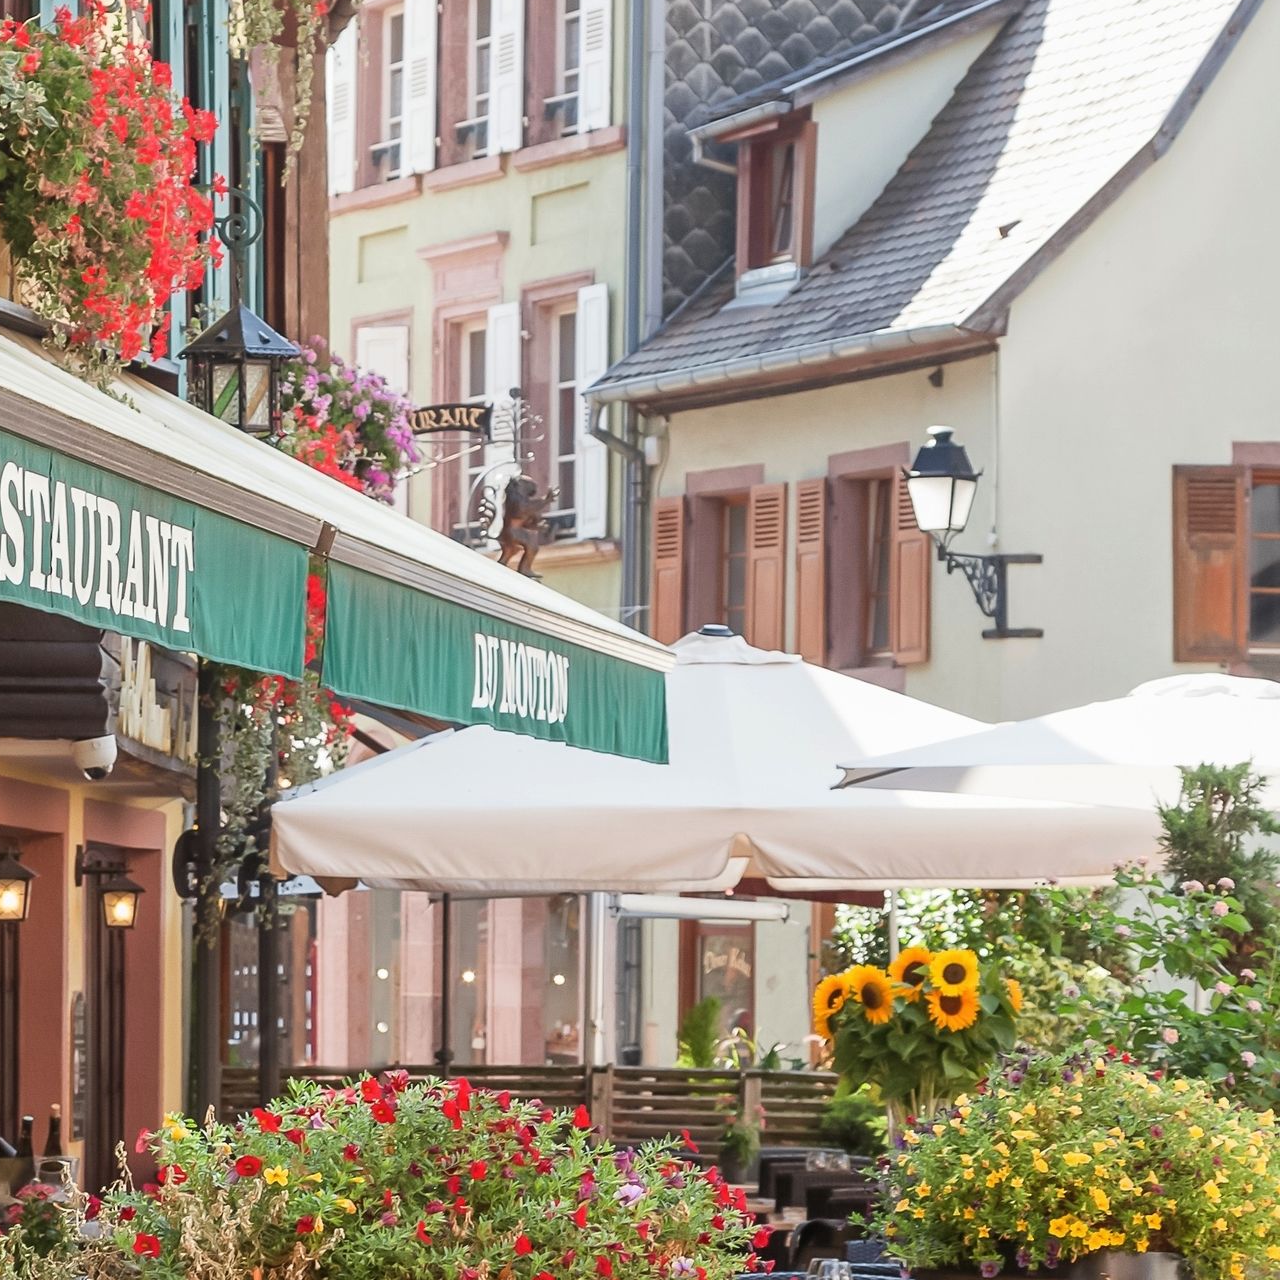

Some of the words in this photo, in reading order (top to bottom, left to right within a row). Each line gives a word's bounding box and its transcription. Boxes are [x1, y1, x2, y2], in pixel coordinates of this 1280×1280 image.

[408, 407, 486, 431] URANT
[472, 633, 500, 713] DU
[499, 639, 570, 724] MOUTON
